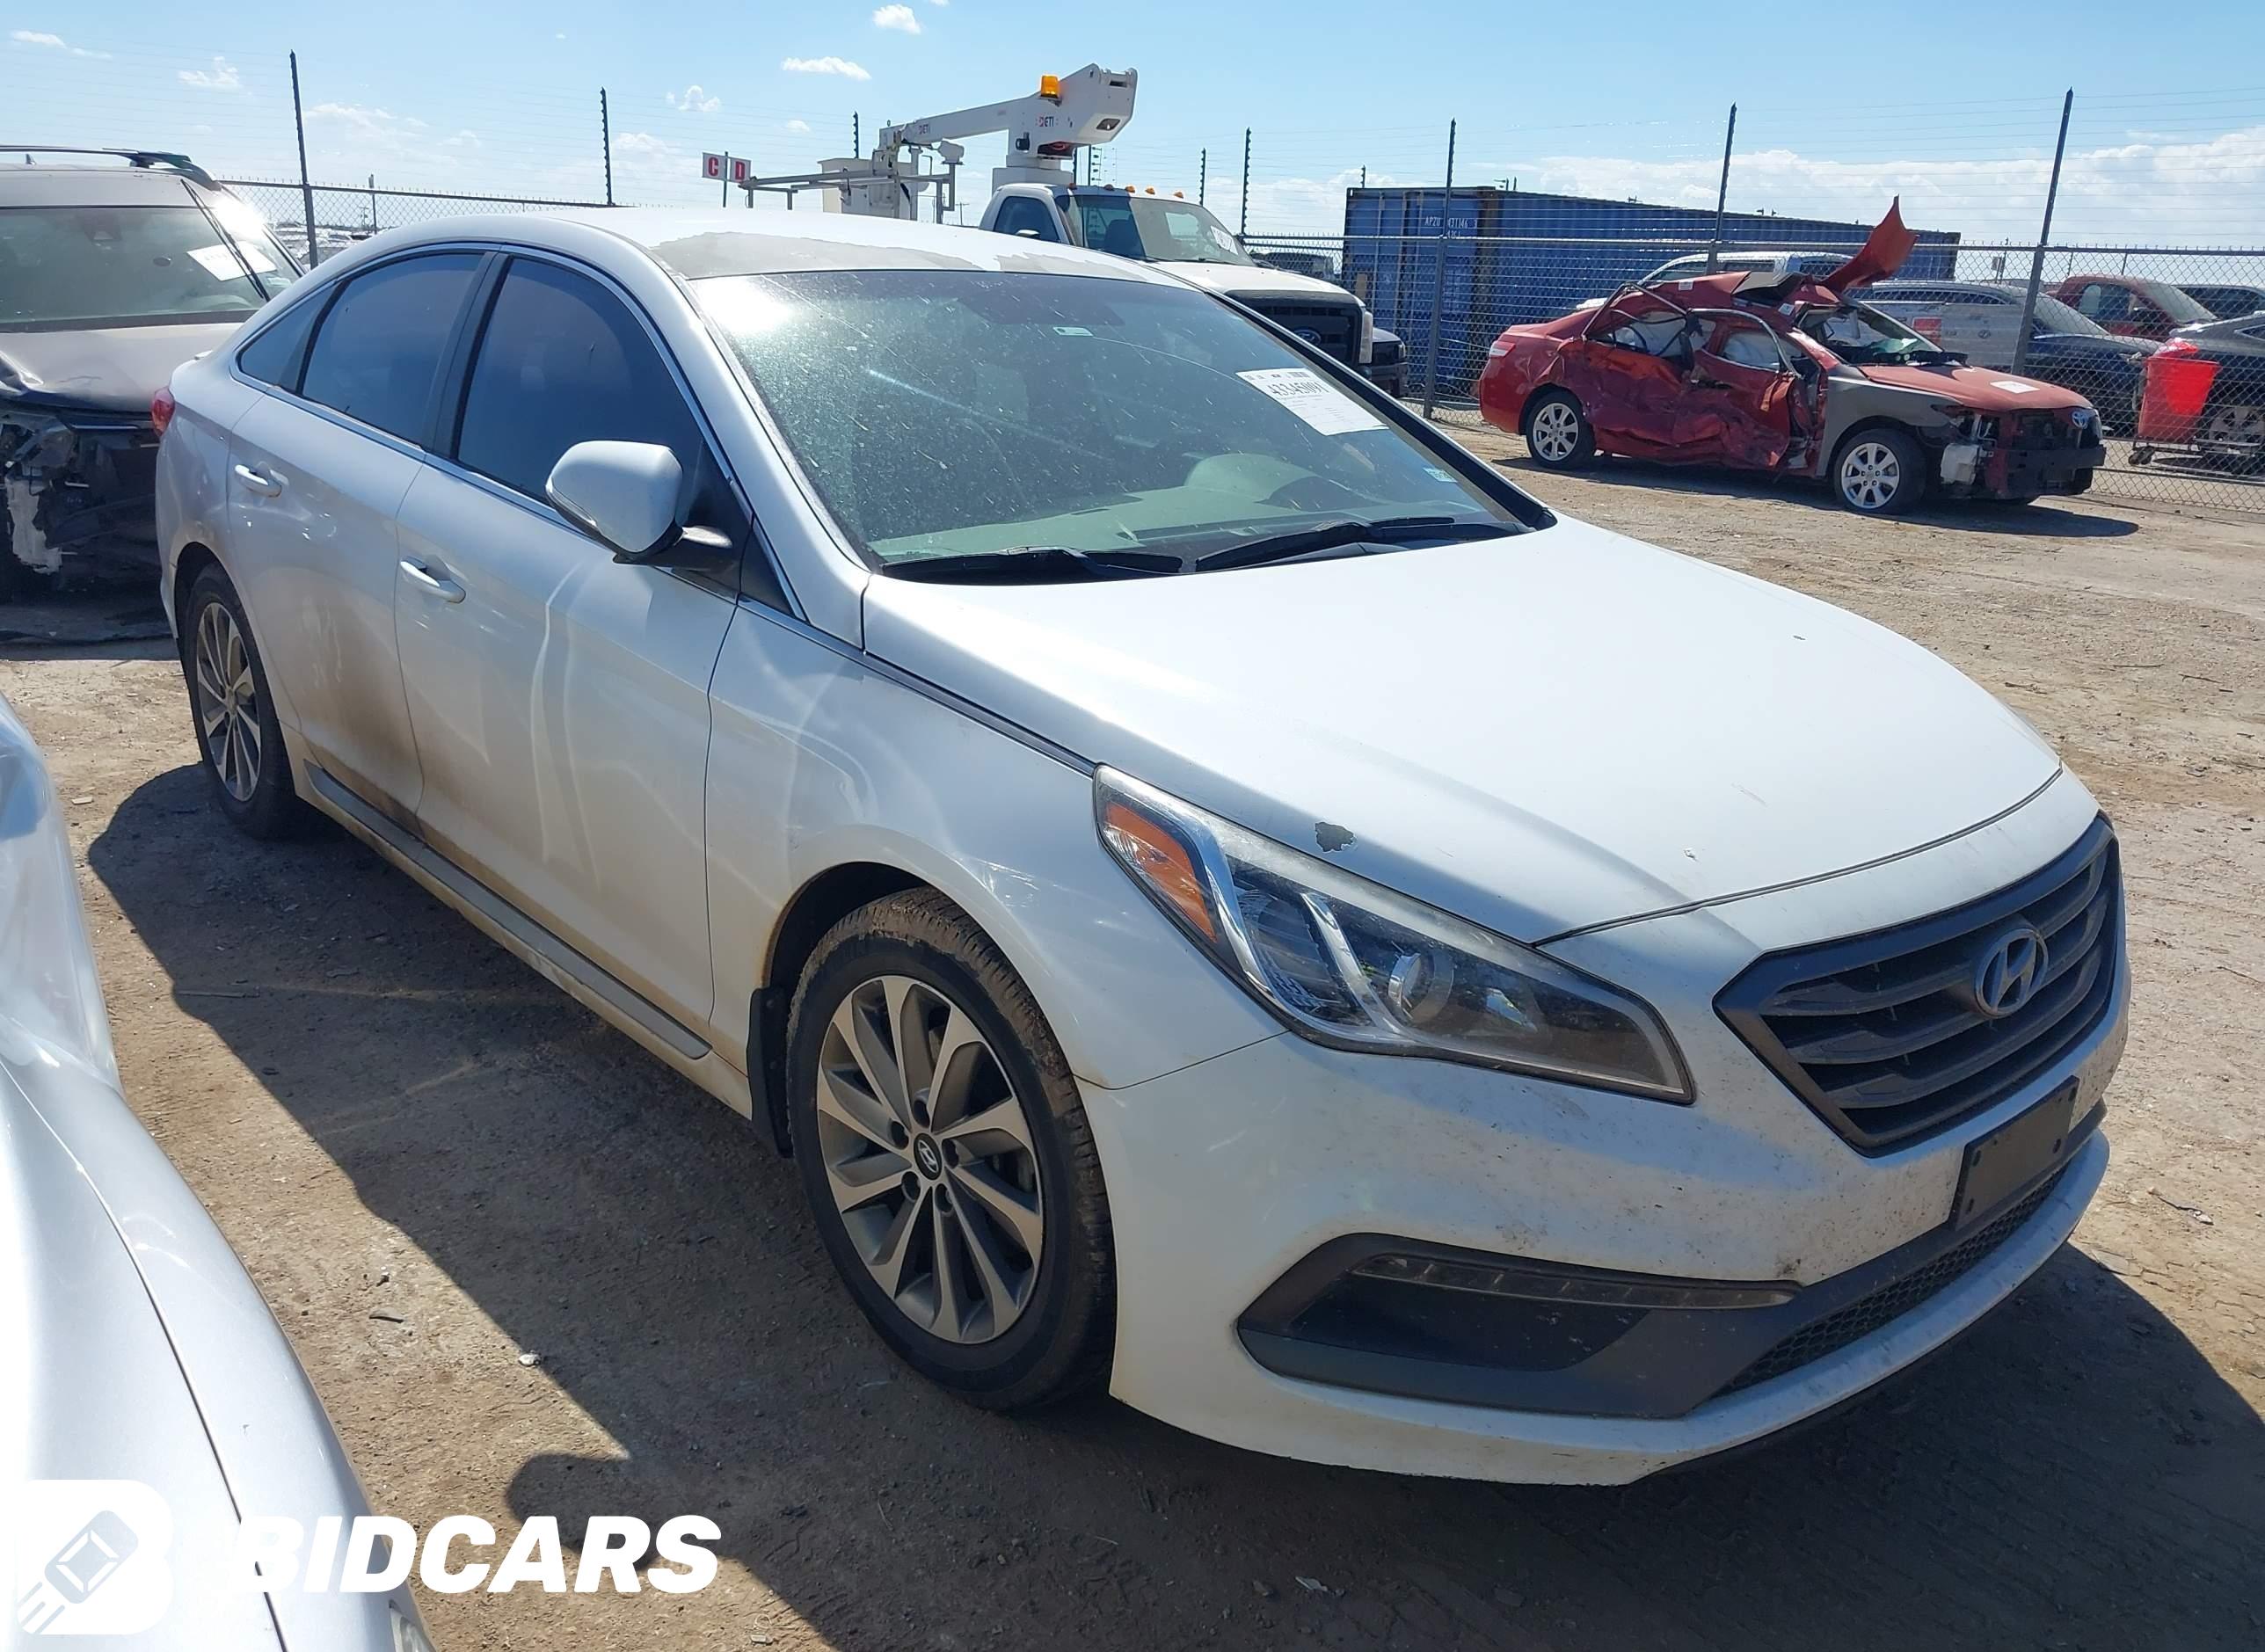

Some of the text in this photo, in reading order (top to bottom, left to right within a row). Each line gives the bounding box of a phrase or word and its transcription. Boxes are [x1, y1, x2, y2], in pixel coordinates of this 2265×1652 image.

[708, 156, 718, 176] C
[735, 161, 746, 180] D
[1424, 216, 1441, 227] APZU
